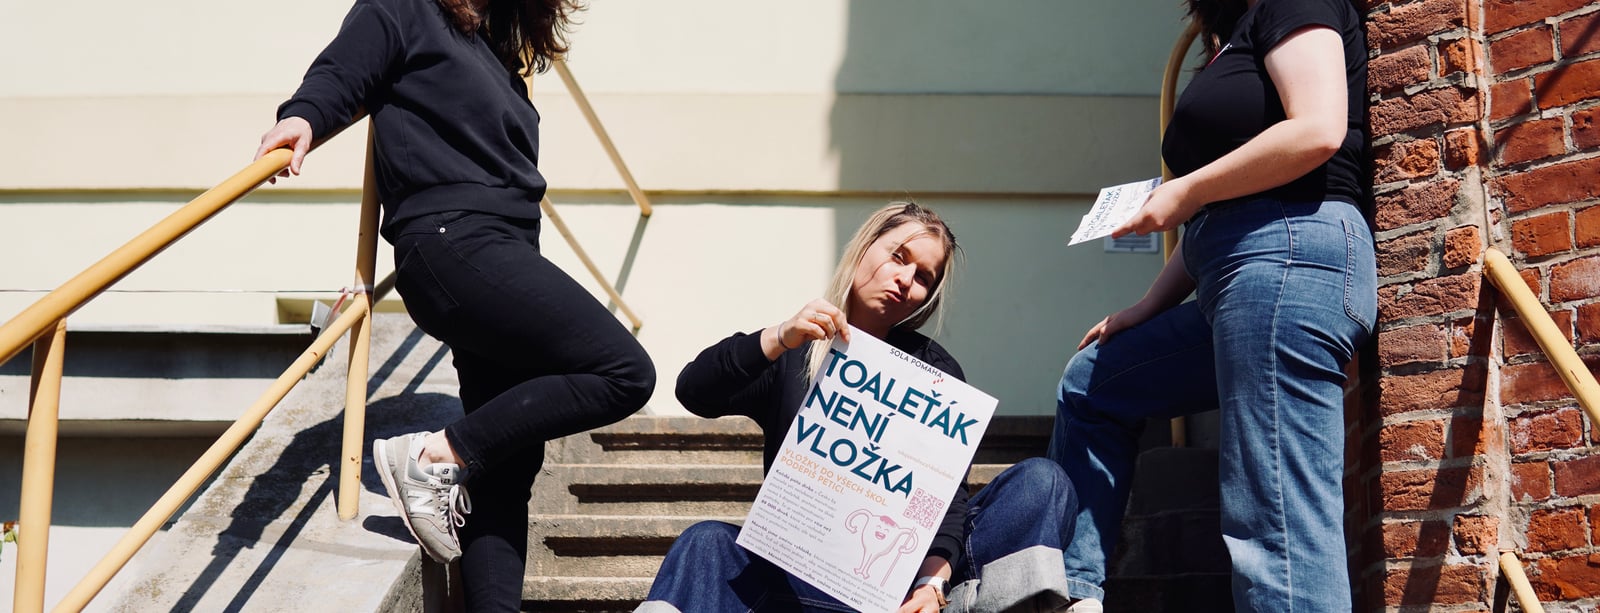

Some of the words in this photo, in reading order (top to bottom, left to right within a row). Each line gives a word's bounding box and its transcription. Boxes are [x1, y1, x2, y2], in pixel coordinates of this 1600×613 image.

[889, 347, 909, 362] SOLA
[805, 381, 895, 443] NENÍ
[825, 348, 979, 446] TOALEŤÁK
[780, 454, 817, 479] PODEPIŠ
[817, 475, 844, 495] PETICI.
[784, 448, 819, 471] VLOŽKY
[820, 467, 834, 478] DO
[836, 474, 864, 494] VŠECH
[865, 487, 889, 507] ŠKOL.
[796, 414, 913, 498] VLOŽKA
